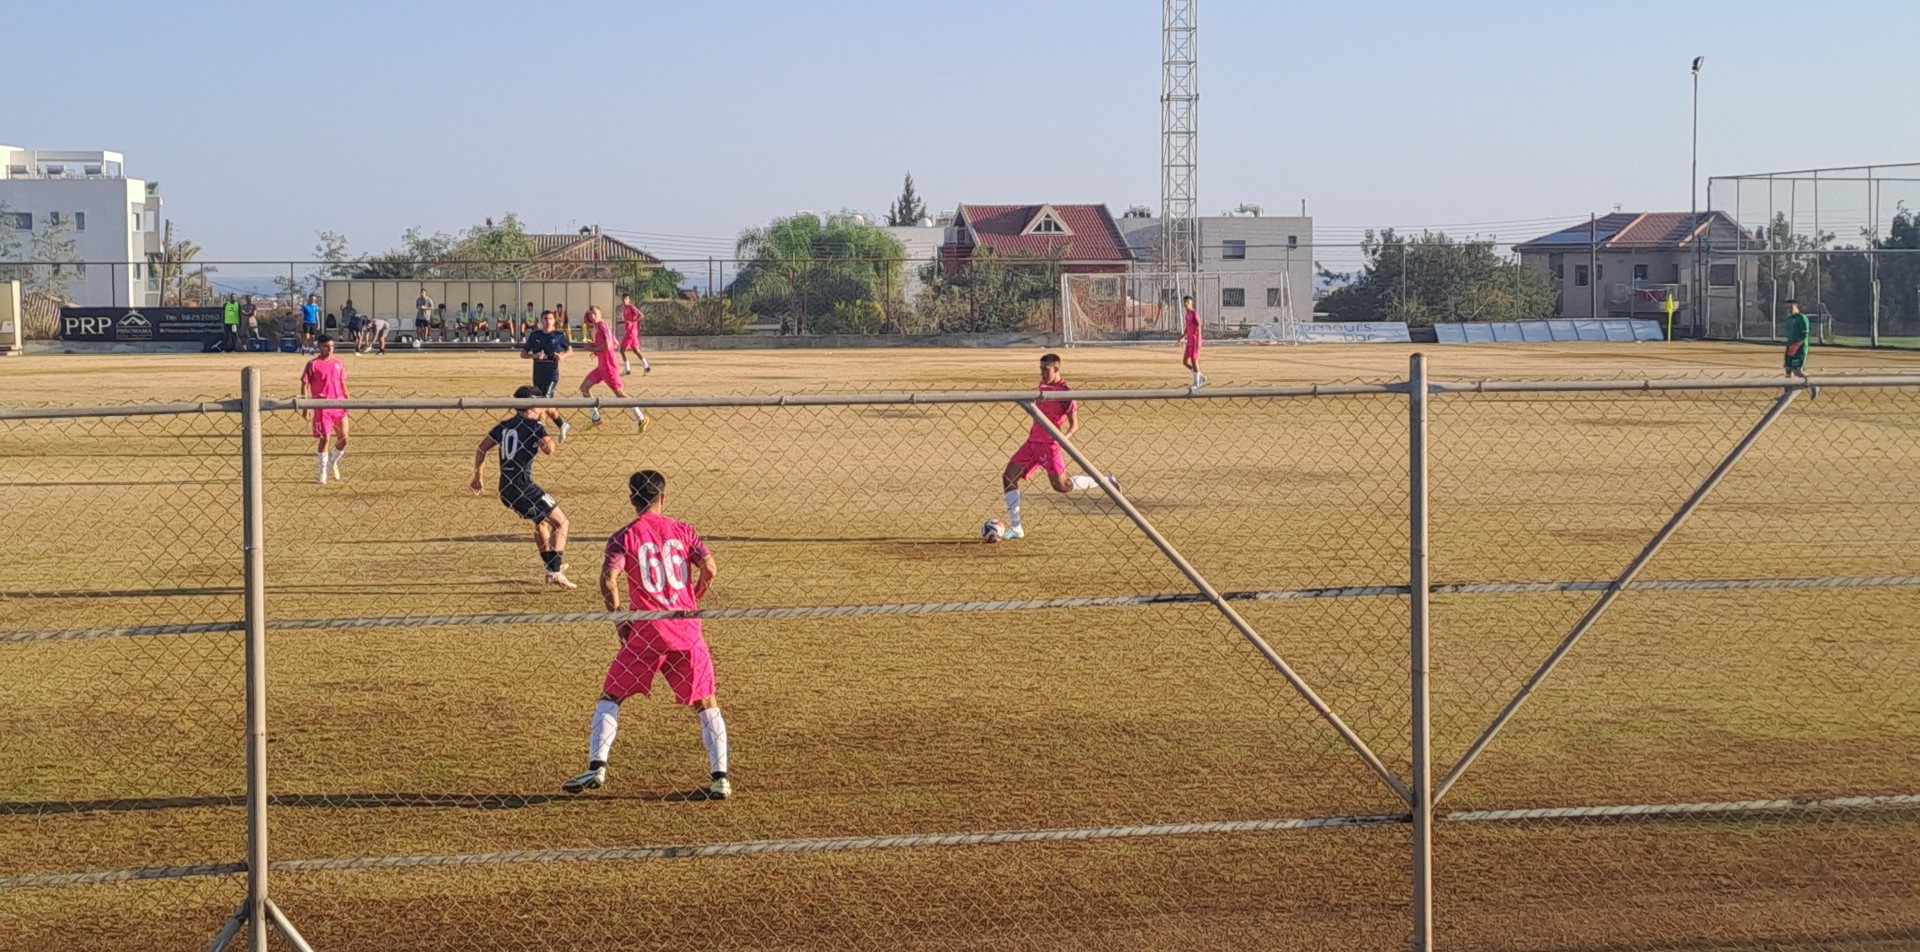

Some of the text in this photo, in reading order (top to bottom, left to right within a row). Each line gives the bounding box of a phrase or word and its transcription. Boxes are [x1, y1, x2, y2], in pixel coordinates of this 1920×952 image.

[65, 317, 112, 335] PRP
[502, 428, 518, 461] 10
[638, 538, 689, 594] 66
